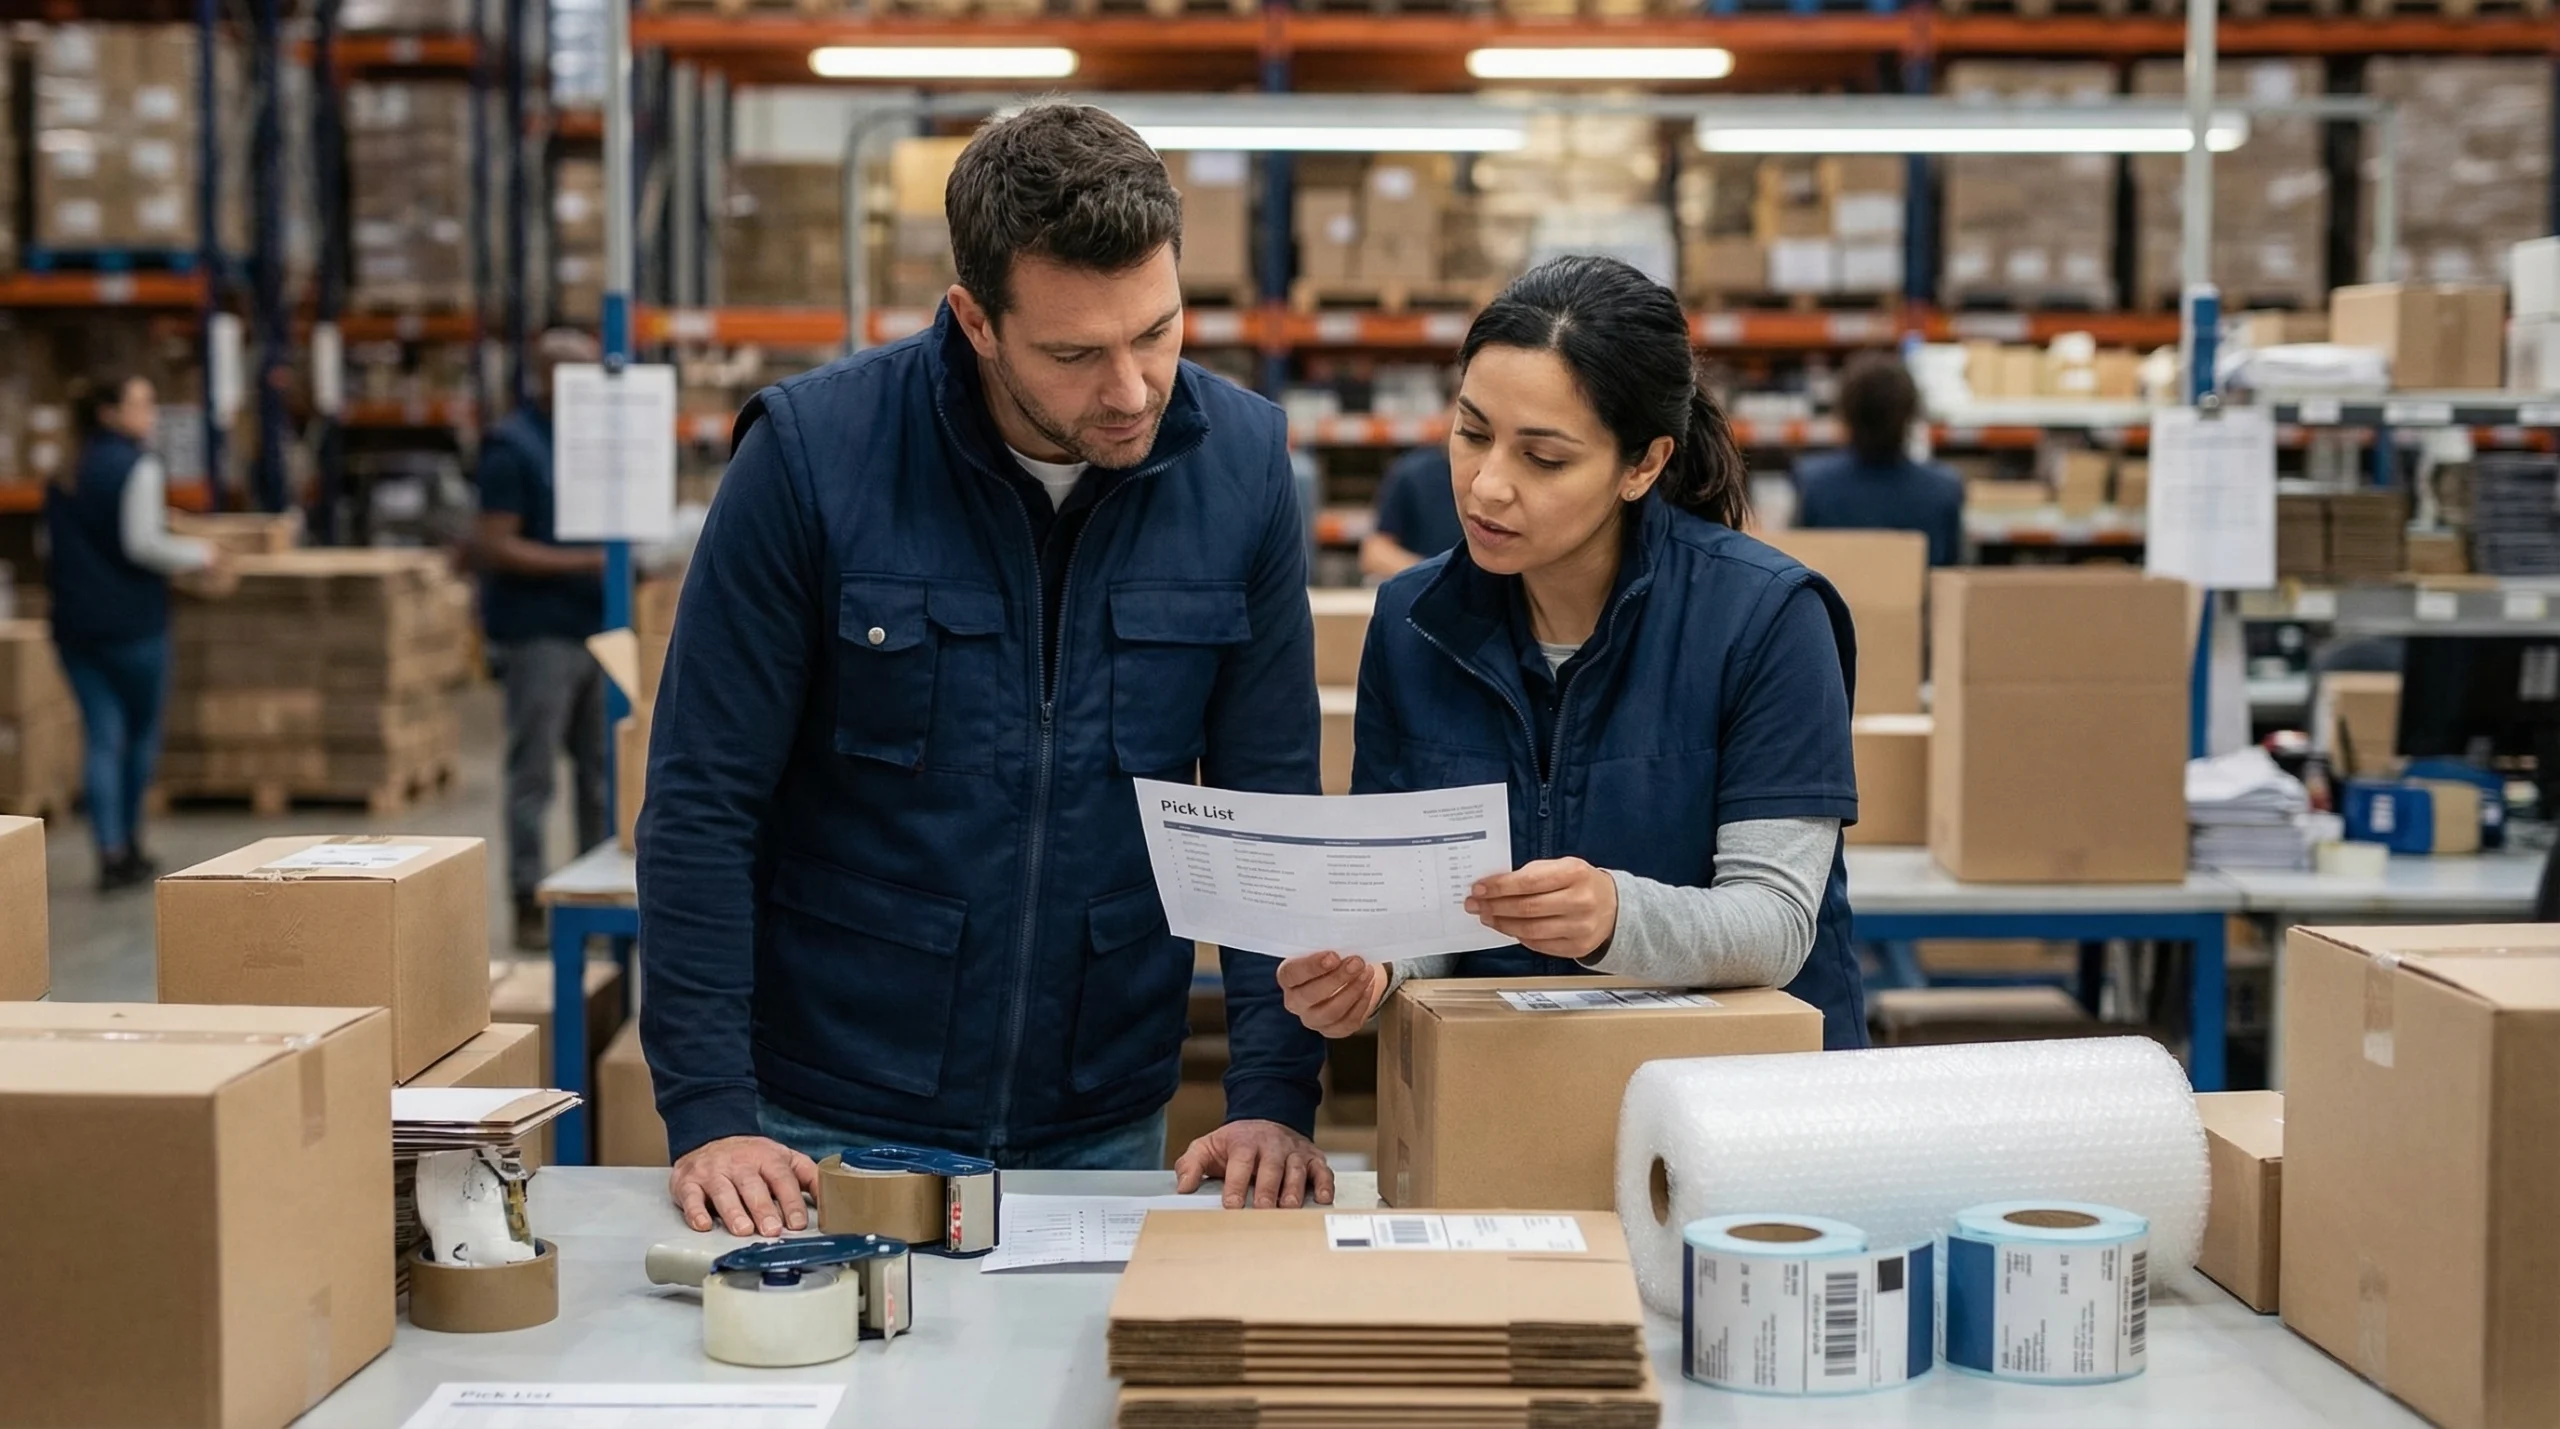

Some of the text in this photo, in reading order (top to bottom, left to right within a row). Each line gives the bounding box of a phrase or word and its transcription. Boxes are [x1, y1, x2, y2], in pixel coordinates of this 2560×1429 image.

[1160, 799, 1235, 822] Pick List
[460, 1390, 506, 1399] Pick
